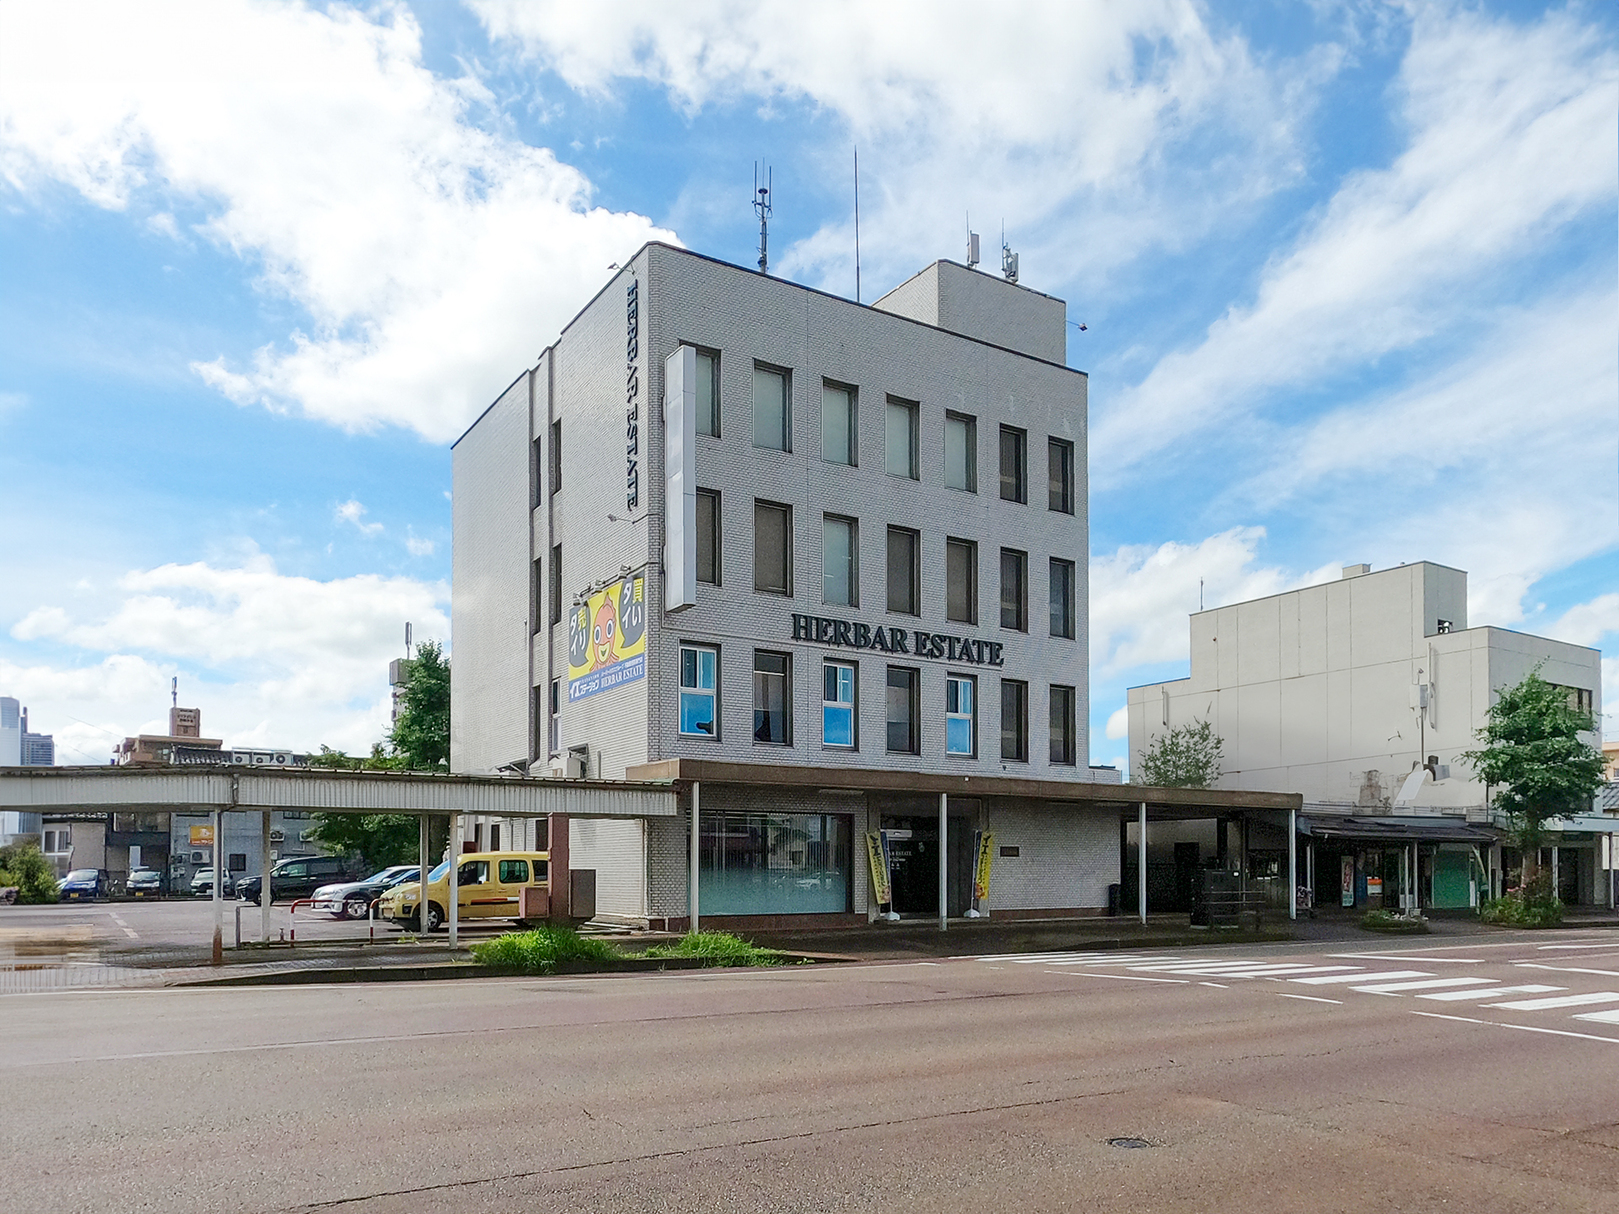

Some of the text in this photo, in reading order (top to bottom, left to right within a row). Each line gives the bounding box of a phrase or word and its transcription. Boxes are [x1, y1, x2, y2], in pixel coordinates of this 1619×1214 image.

[627, 279, 638, 512] HERBAR ESTATE
[622, 582, 633, 629] タイ
[570, 614, 578, 656] タイ
[577, 607, 587, 650] 売り
[791, 613, 1004, 666] HERBAR ESTATE
[601, 670, 622, 688] HERBAR
[623, 664, 644, 680] ESTATE
